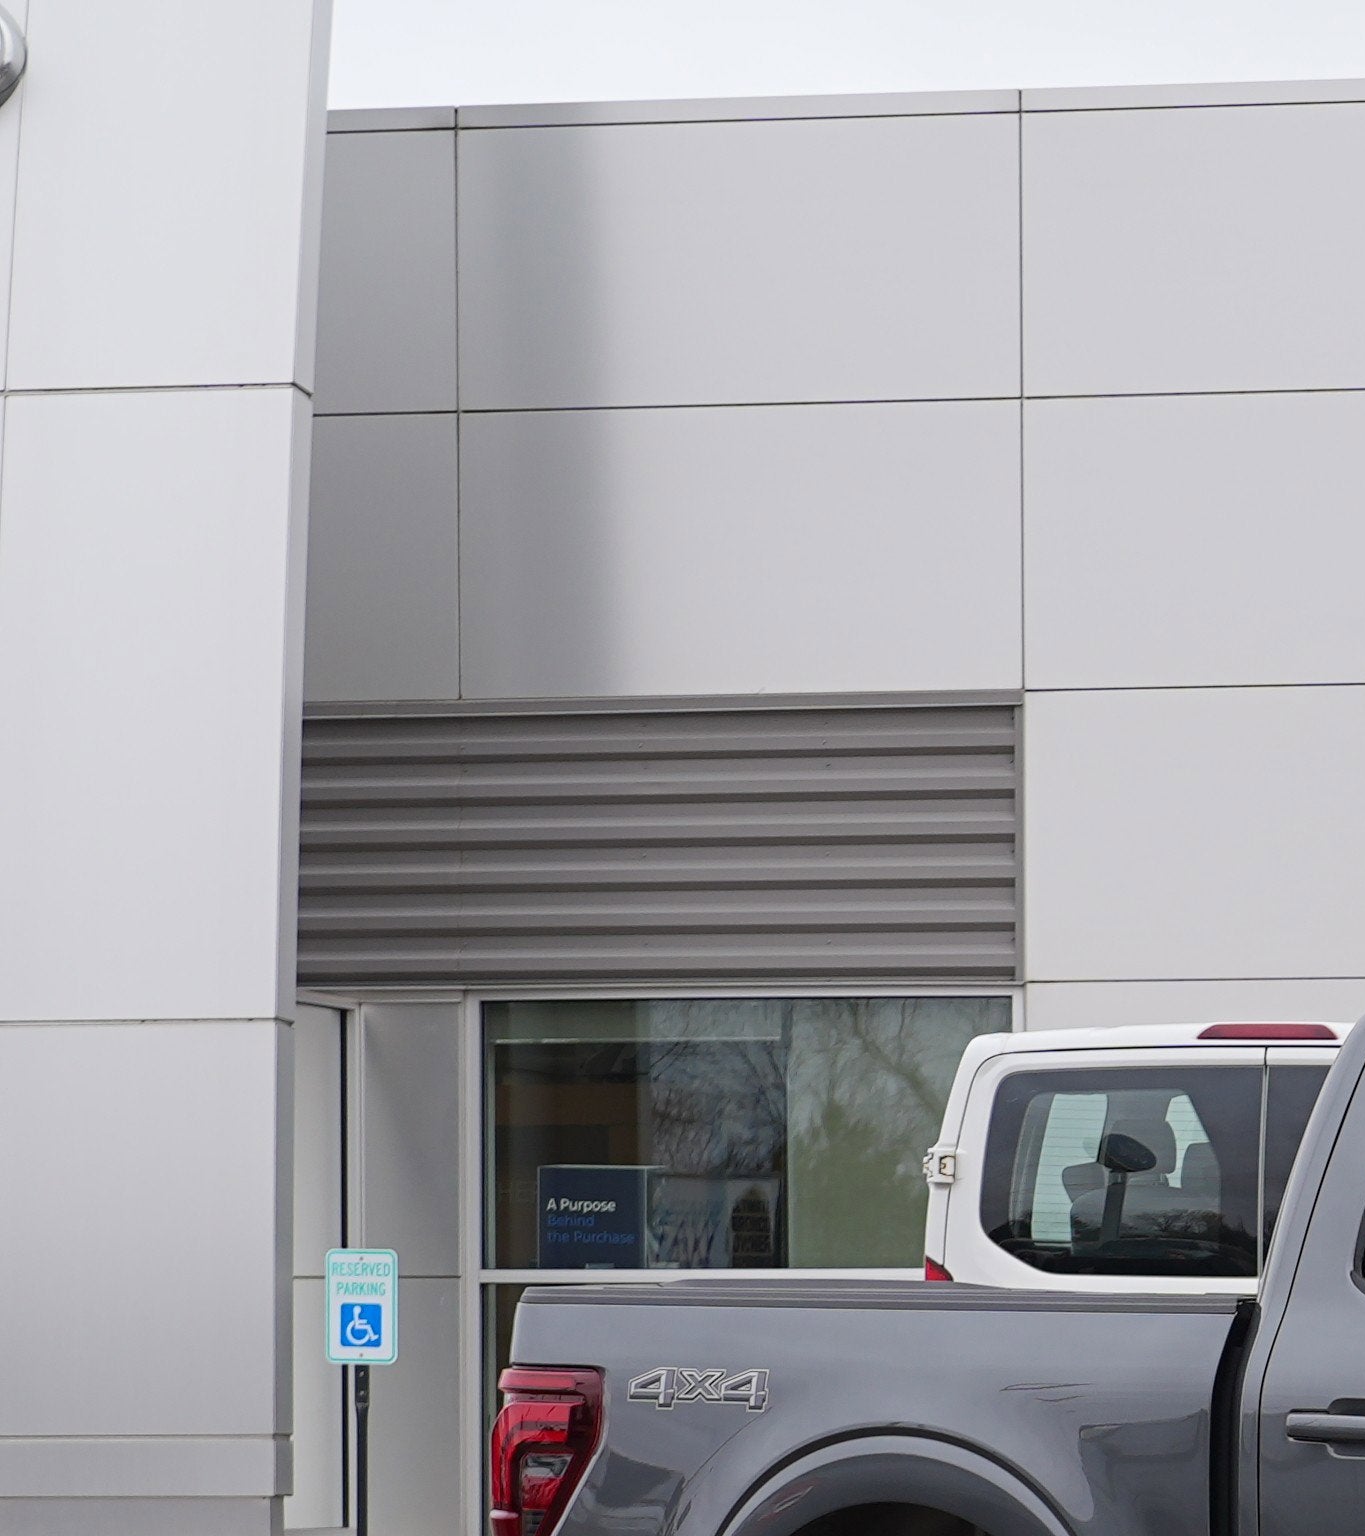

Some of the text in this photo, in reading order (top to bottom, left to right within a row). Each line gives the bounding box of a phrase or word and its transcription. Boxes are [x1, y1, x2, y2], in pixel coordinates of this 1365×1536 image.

[546, 1198, 617, 1214] A Purpose
[547, 1214, 596, 1227] Behind
[547, 1230, 636, 1245] the Purchase
[331, 1261, 391, 1277] RESERVED
[336, 1281, 386, 1296] PARKING
